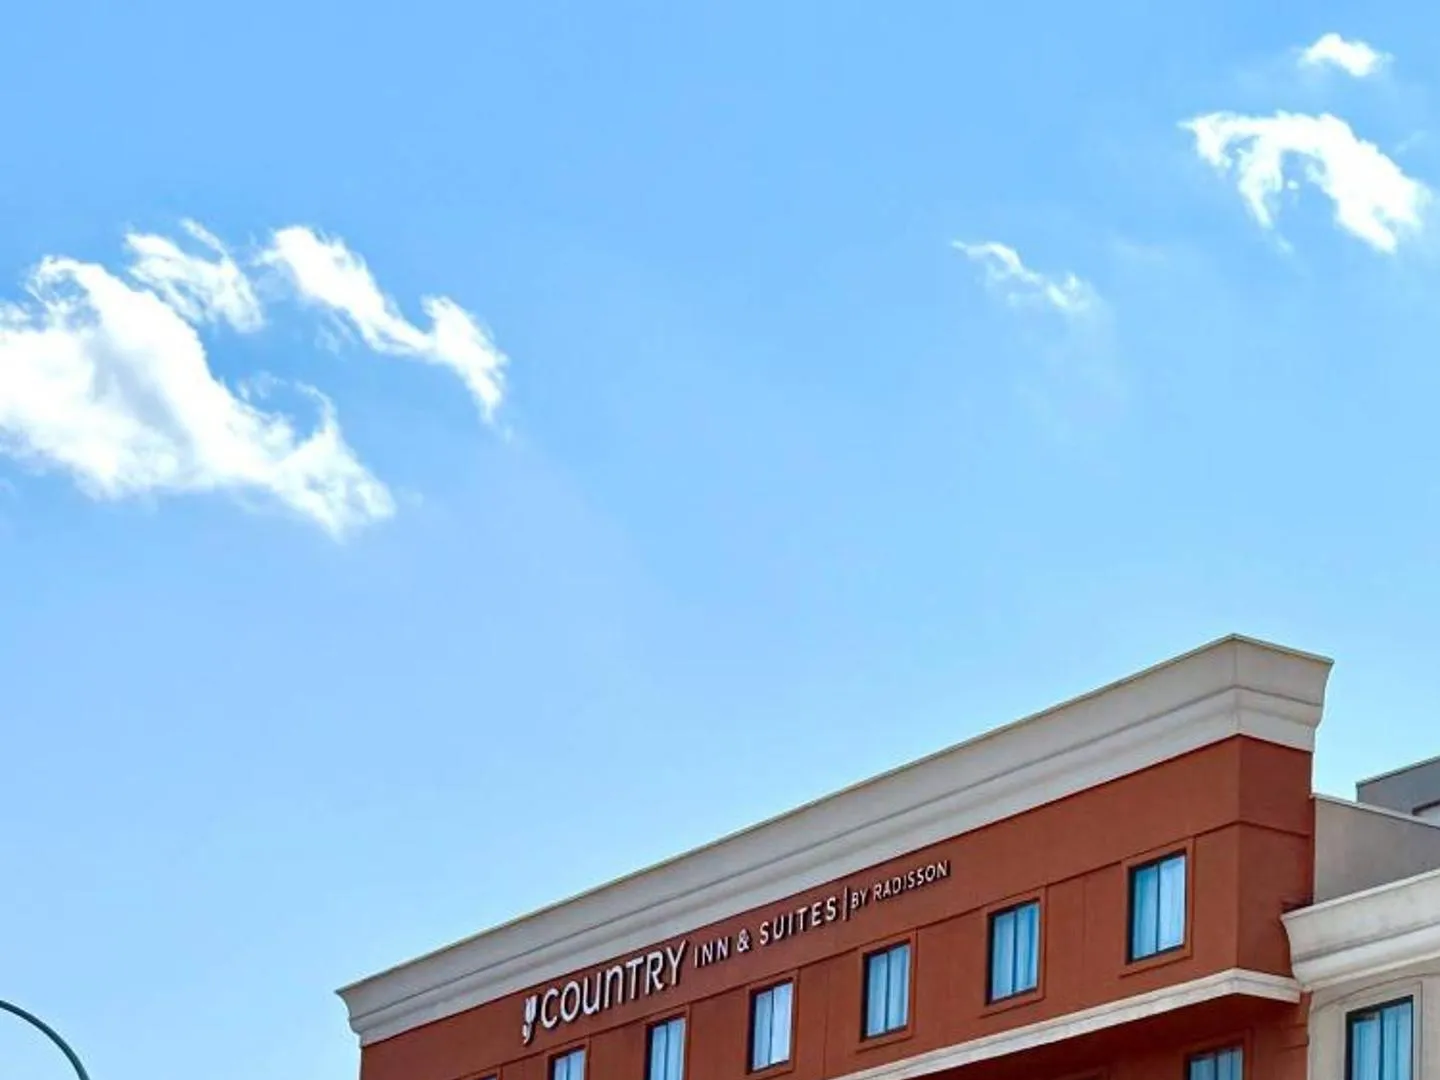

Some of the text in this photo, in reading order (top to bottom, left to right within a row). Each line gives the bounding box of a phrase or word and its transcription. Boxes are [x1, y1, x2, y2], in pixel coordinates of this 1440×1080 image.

[540, 859, 949, 1029] COUNTRY INN & SUITES BY RADISSON
